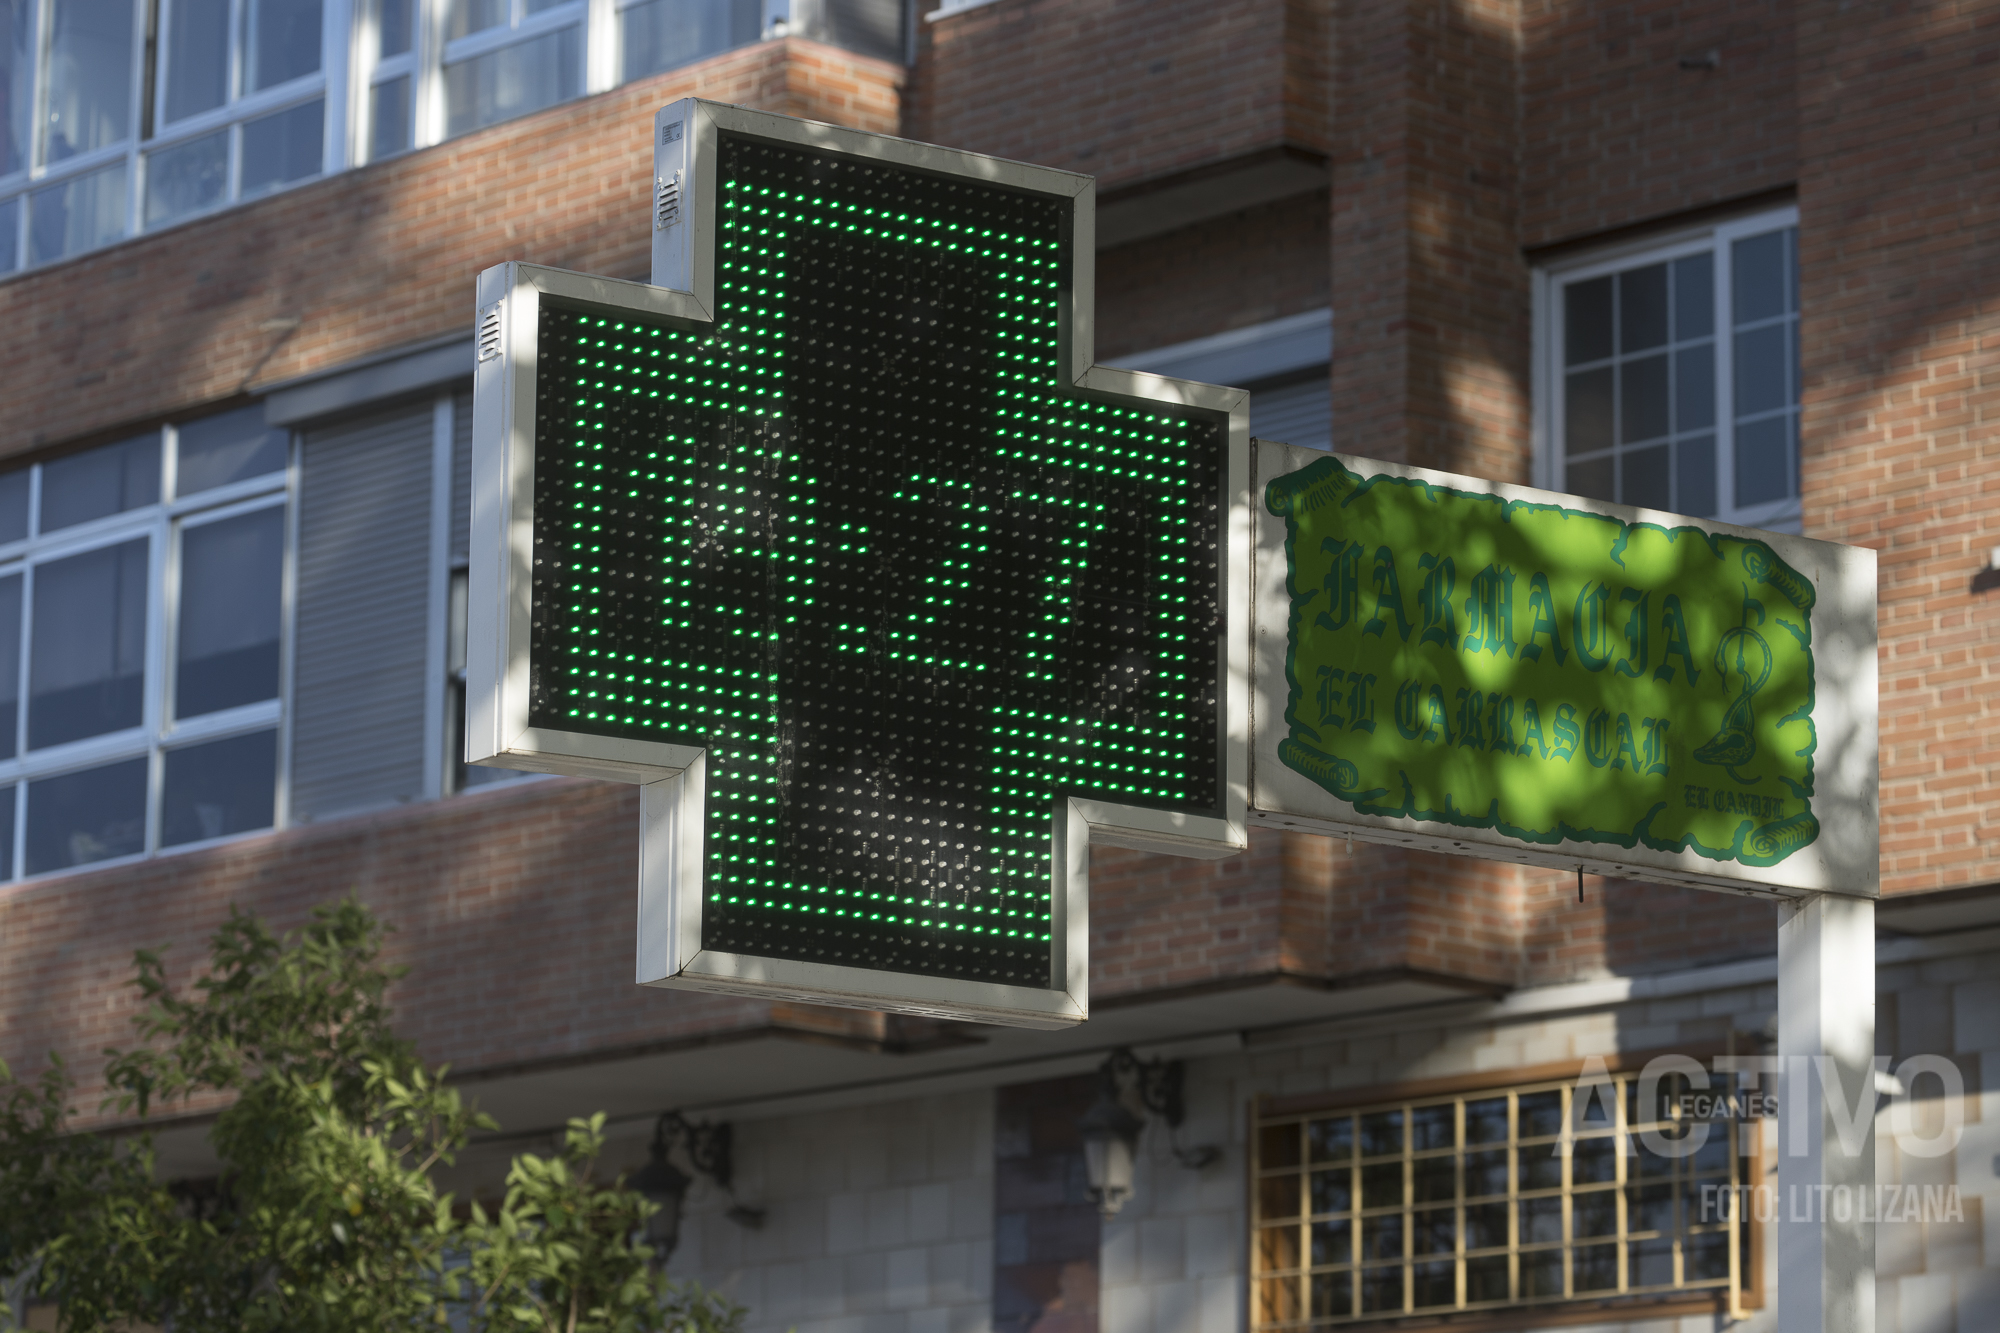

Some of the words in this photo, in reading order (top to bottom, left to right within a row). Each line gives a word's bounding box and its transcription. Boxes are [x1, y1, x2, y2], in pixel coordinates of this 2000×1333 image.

[626, 434, 1106, 682] 19:27
[1314, 536, 1700, 688] FARMACIA
[1315, 665, 1377, 733] EL
[1395, 677, 1671, 777] CARRASCAL
[1684, 784, 1709, 810] EL
[1713, 788, 1784, 820] CANDIL
